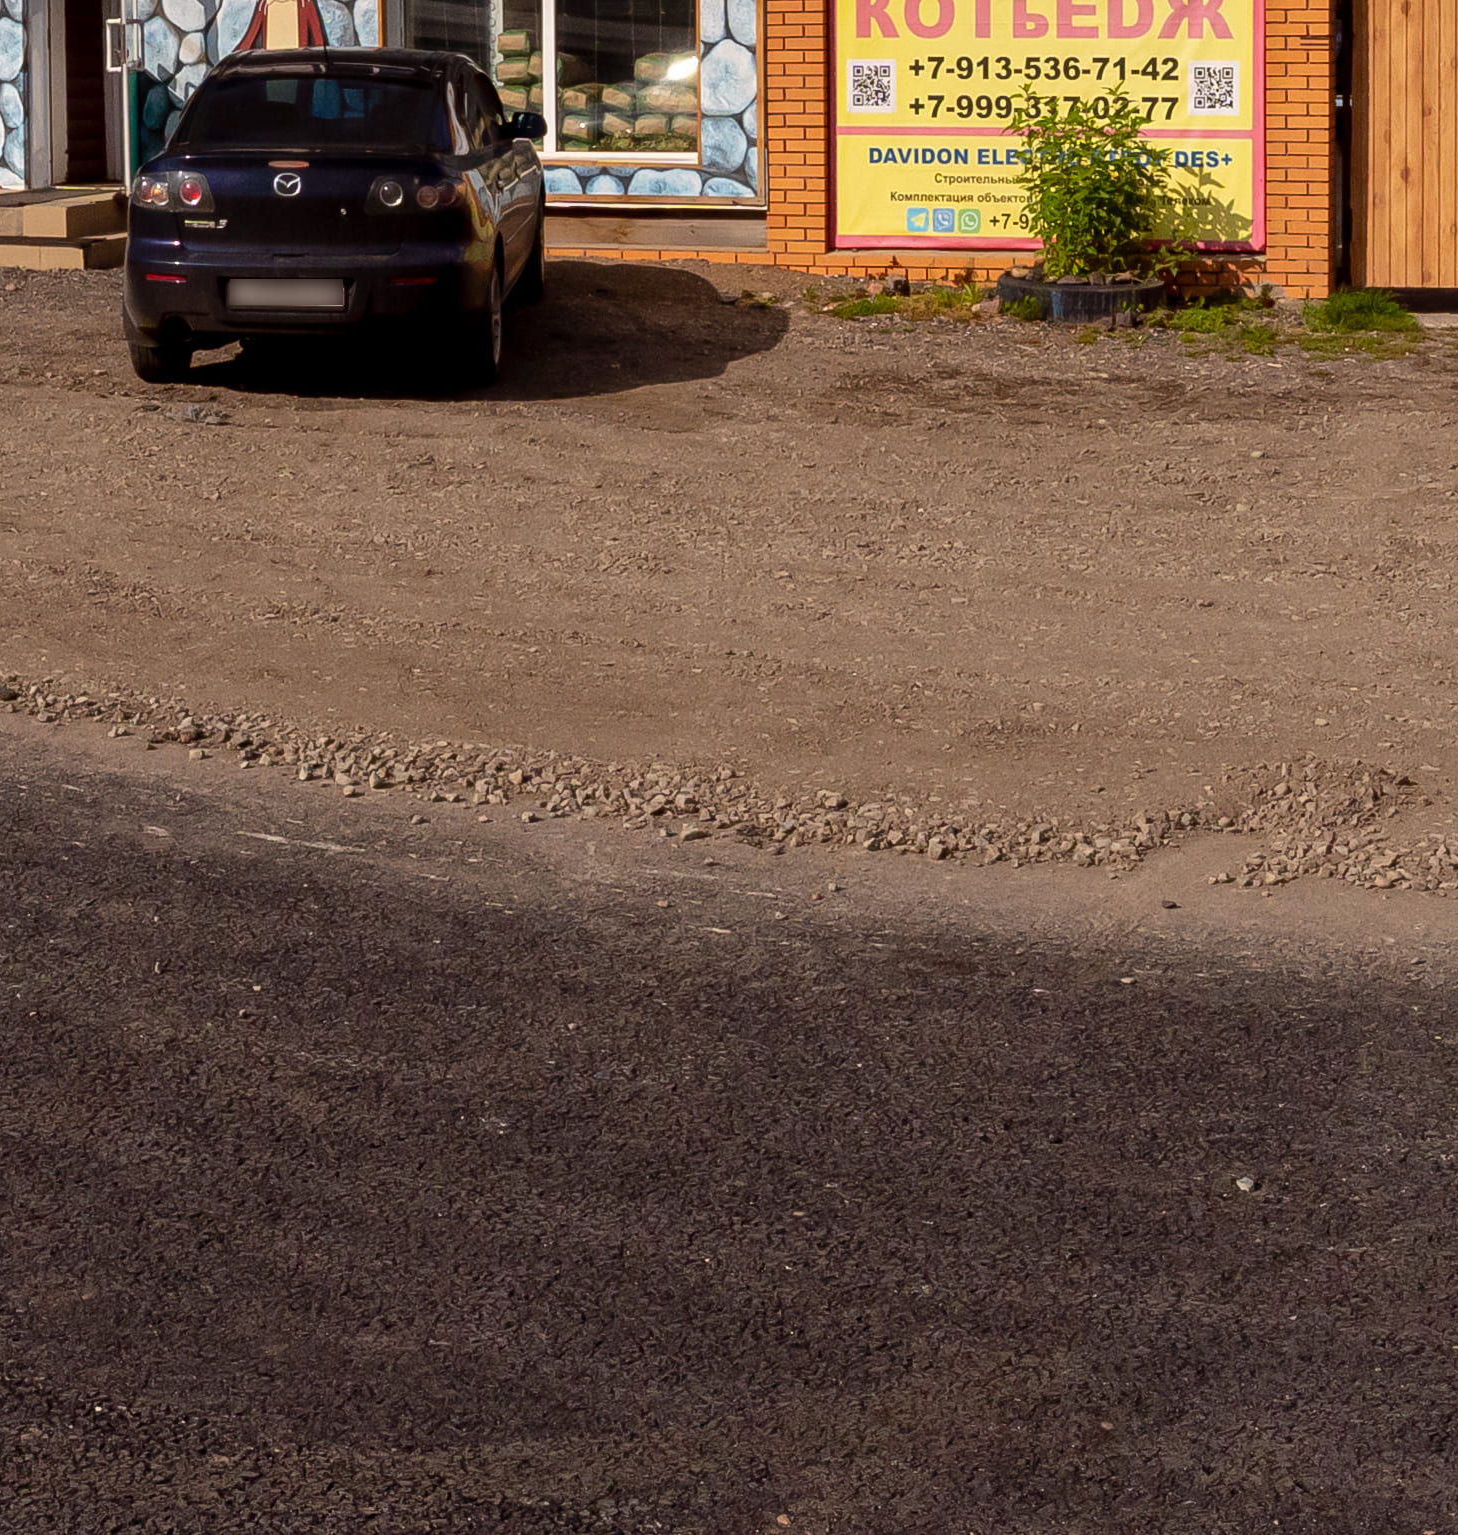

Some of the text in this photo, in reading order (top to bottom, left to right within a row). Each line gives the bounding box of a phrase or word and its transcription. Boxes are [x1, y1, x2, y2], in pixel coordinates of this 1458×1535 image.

[909, 56, 1179, 81] +7-913-536-71-42
[869, 147, 969, 165] DAVIDON
[1175, 151, 1233, 168] DES+
[890, 192, 974, 204] Комплектация
[977, 192, 1034, 204] объектов
